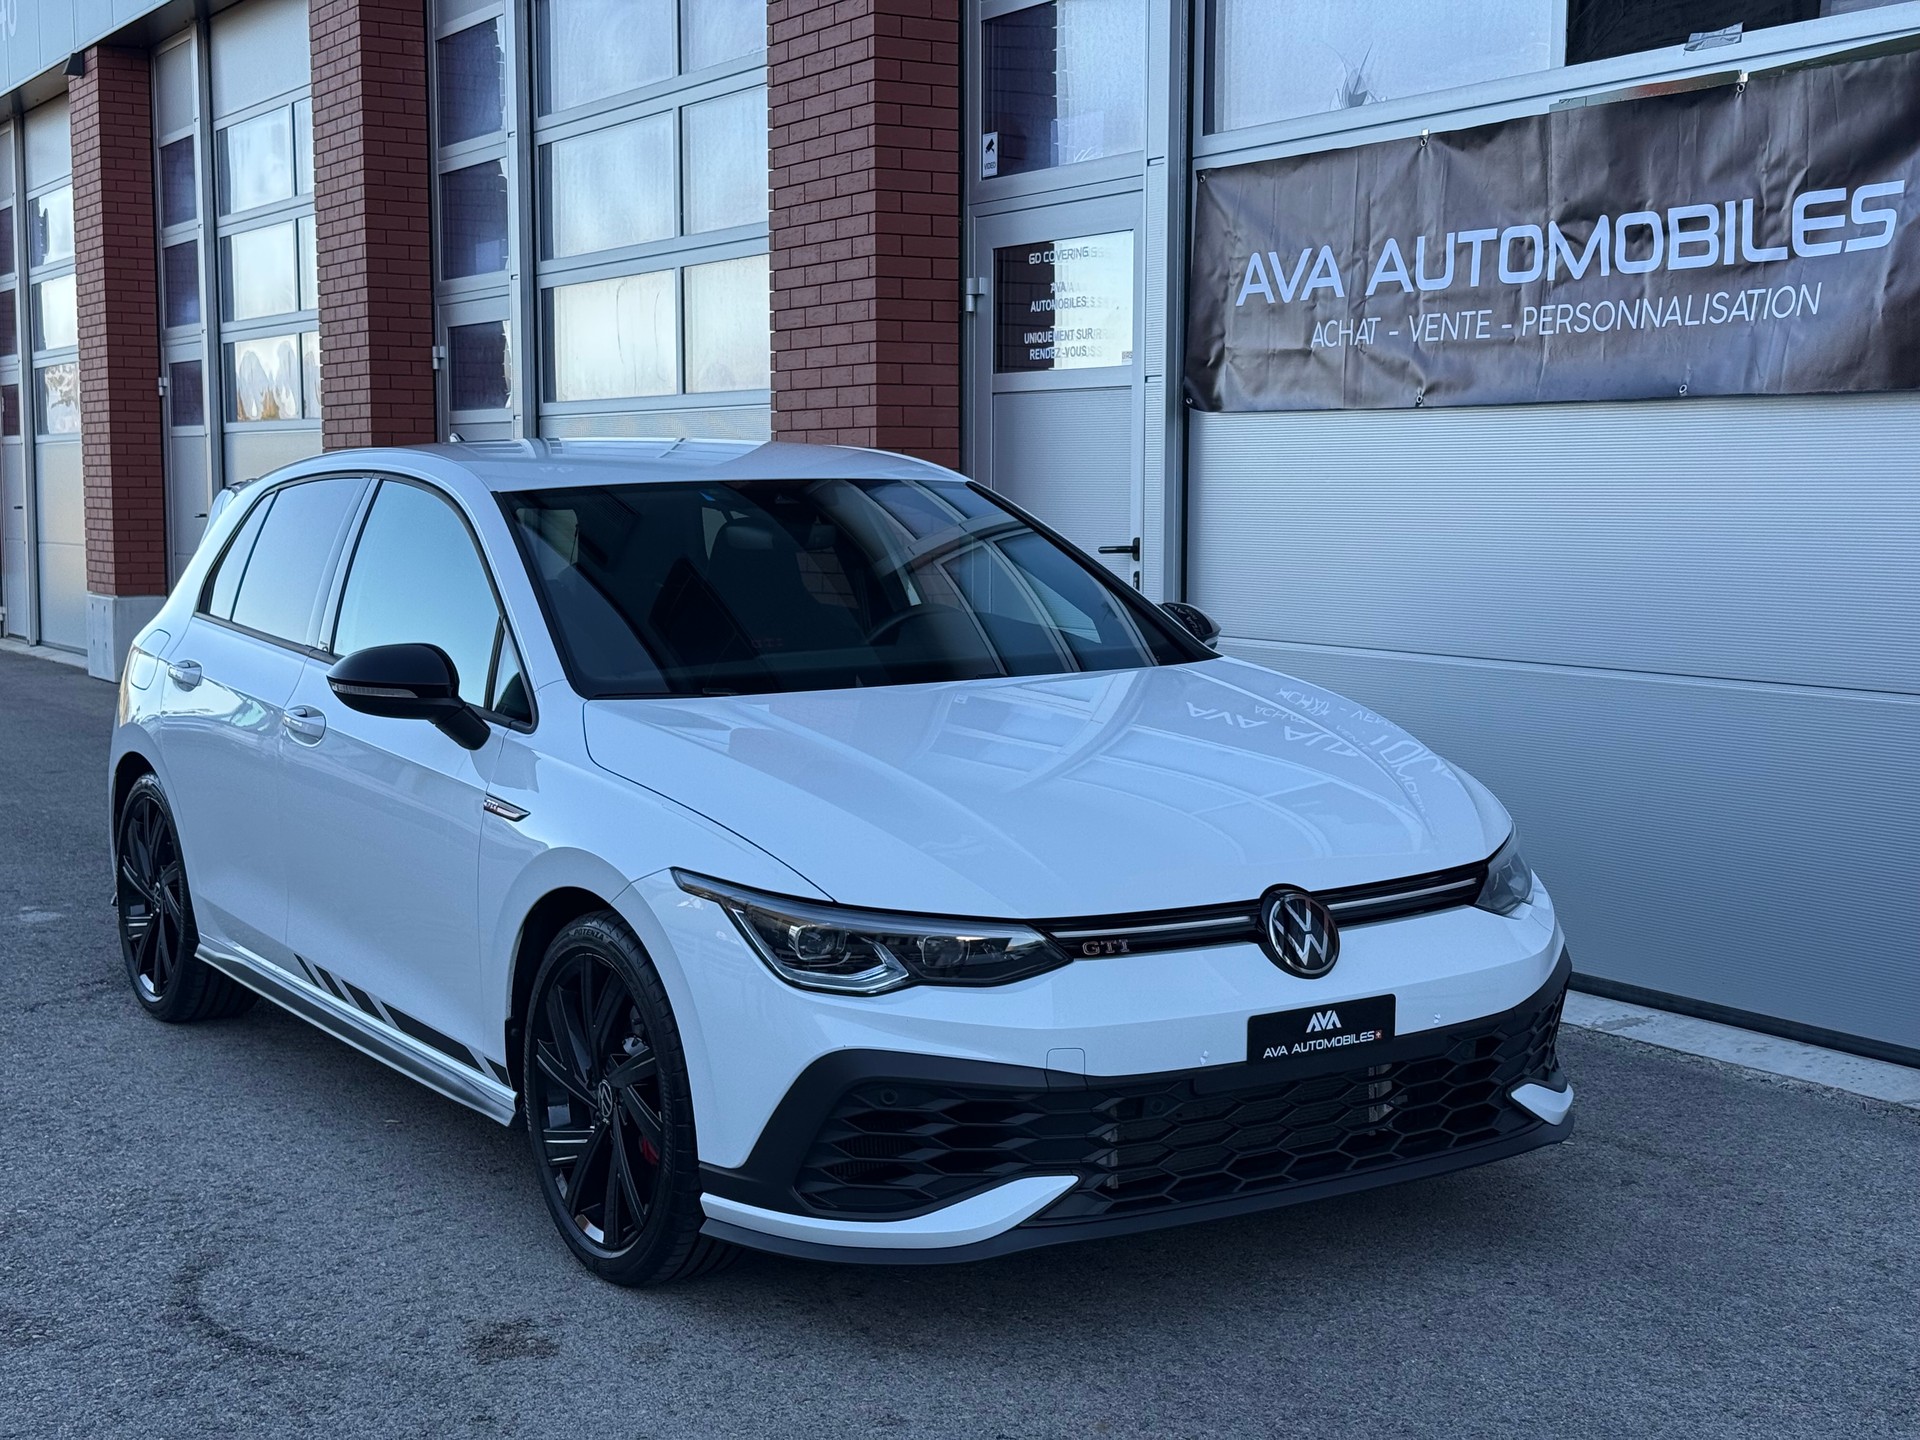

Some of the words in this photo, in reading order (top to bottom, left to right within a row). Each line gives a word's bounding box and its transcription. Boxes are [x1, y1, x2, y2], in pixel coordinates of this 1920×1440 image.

[1236, 245, 1345, 306] AVA
[1365, 180, 1905, 296] AUTOMOBILES
[1043, 246, 1089, 262] COVERING
[1050, 281, 1066, 294] AVA
[1030, 296, 1087, 313] AUTOMOBILES
[1310, 317, 1381, 348] ACHAT
[1409, 309, 1493, 342] VENTE
[1522, 282, 1822, 337] PERSONNALISATION
[1024, 329, 1075, 344] UNIQUEMENT
[1076, 328, 1094, 340] SUR
[1029, 345, 1087, 360] RENDEZ-VOUS
[573, 928, 604, 941] POTENZA
[1082, 939, 1130, 956] GTI
[1305, 1010, 1342, 1033] AVA
[1263, 1045, 1288, 1059] AVA
[1291, 1030, 1375, 1054] AUTOMOBILES
